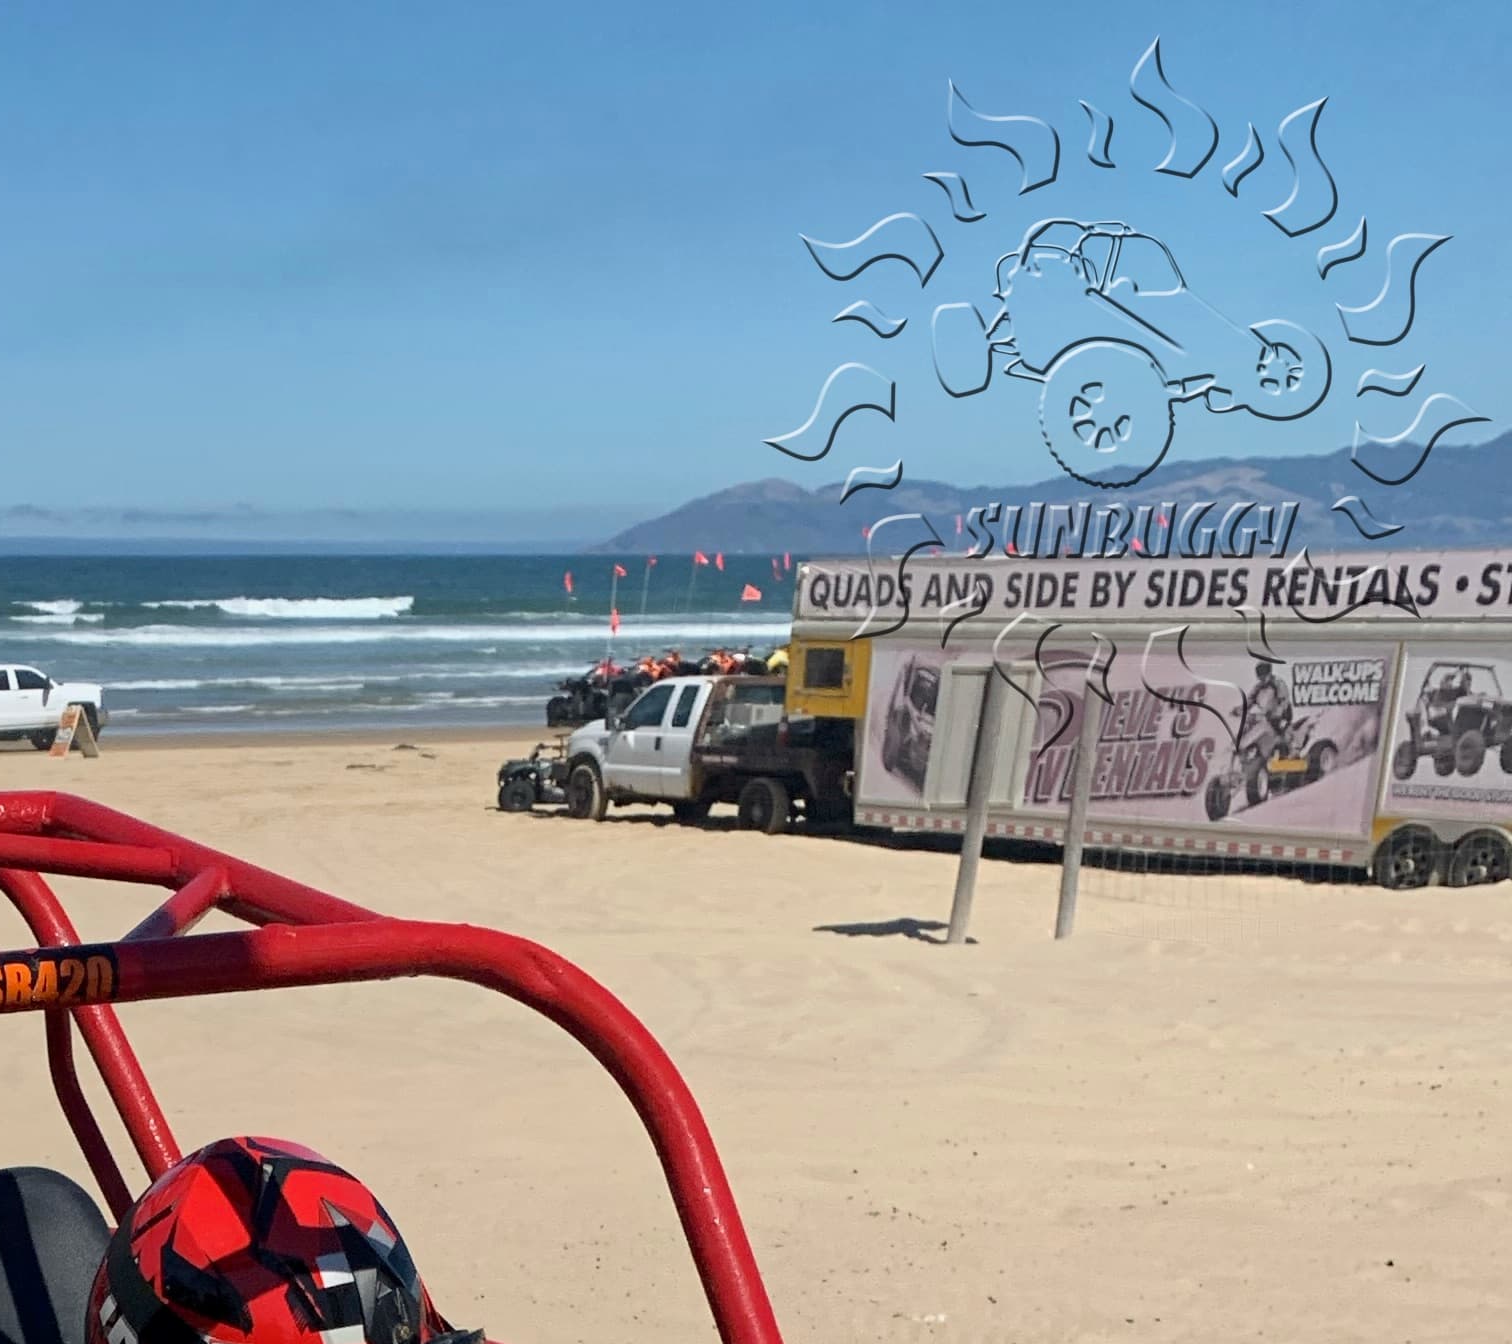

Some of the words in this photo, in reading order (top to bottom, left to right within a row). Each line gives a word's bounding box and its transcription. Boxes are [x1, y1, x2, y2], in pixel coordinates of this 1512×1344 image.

[809, 571, 913, 610] QUADS
[921, 571, 993, 608] AND
[1004, 570, 1080, 609] SIDE
[1090, 570, 1136, 608] BY
[1144, 567, 1250, 608] SIDES
[1261, 563, 1441, 608] RENTALS
[1293, 660, 1385, 683] WALK-UPS
[1293, 682, 1382, 705] WELCOME
